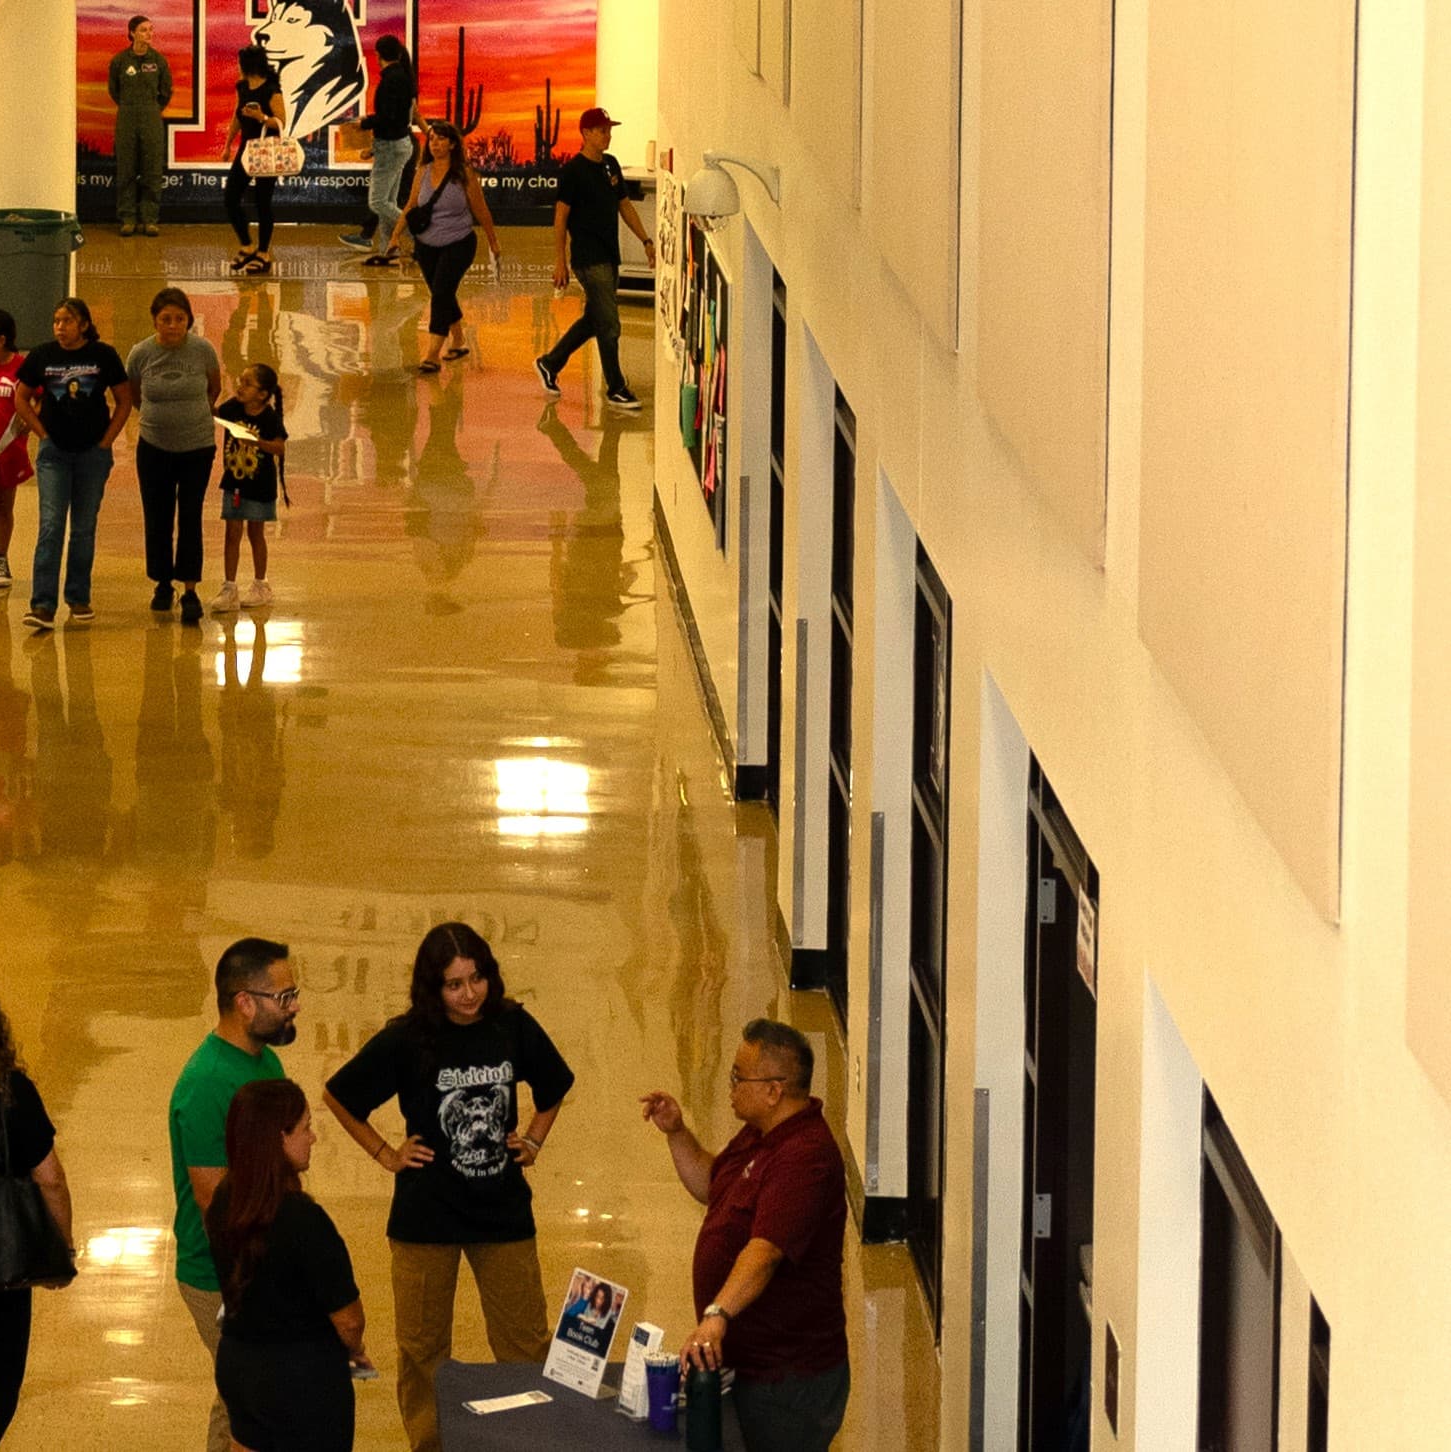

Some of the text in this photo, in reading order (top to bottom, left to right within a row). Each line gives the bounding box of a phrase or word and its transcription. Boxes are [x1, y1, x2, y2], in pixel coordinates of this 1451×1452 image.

[90, 175, 113, 187] my
[191, 173, 217, 185] The
[288, 175, 312, 188] my
[315, 176, 371, 188] respons
[501, 176, 524, 190] my
[528, 175, 558, 188] cha
